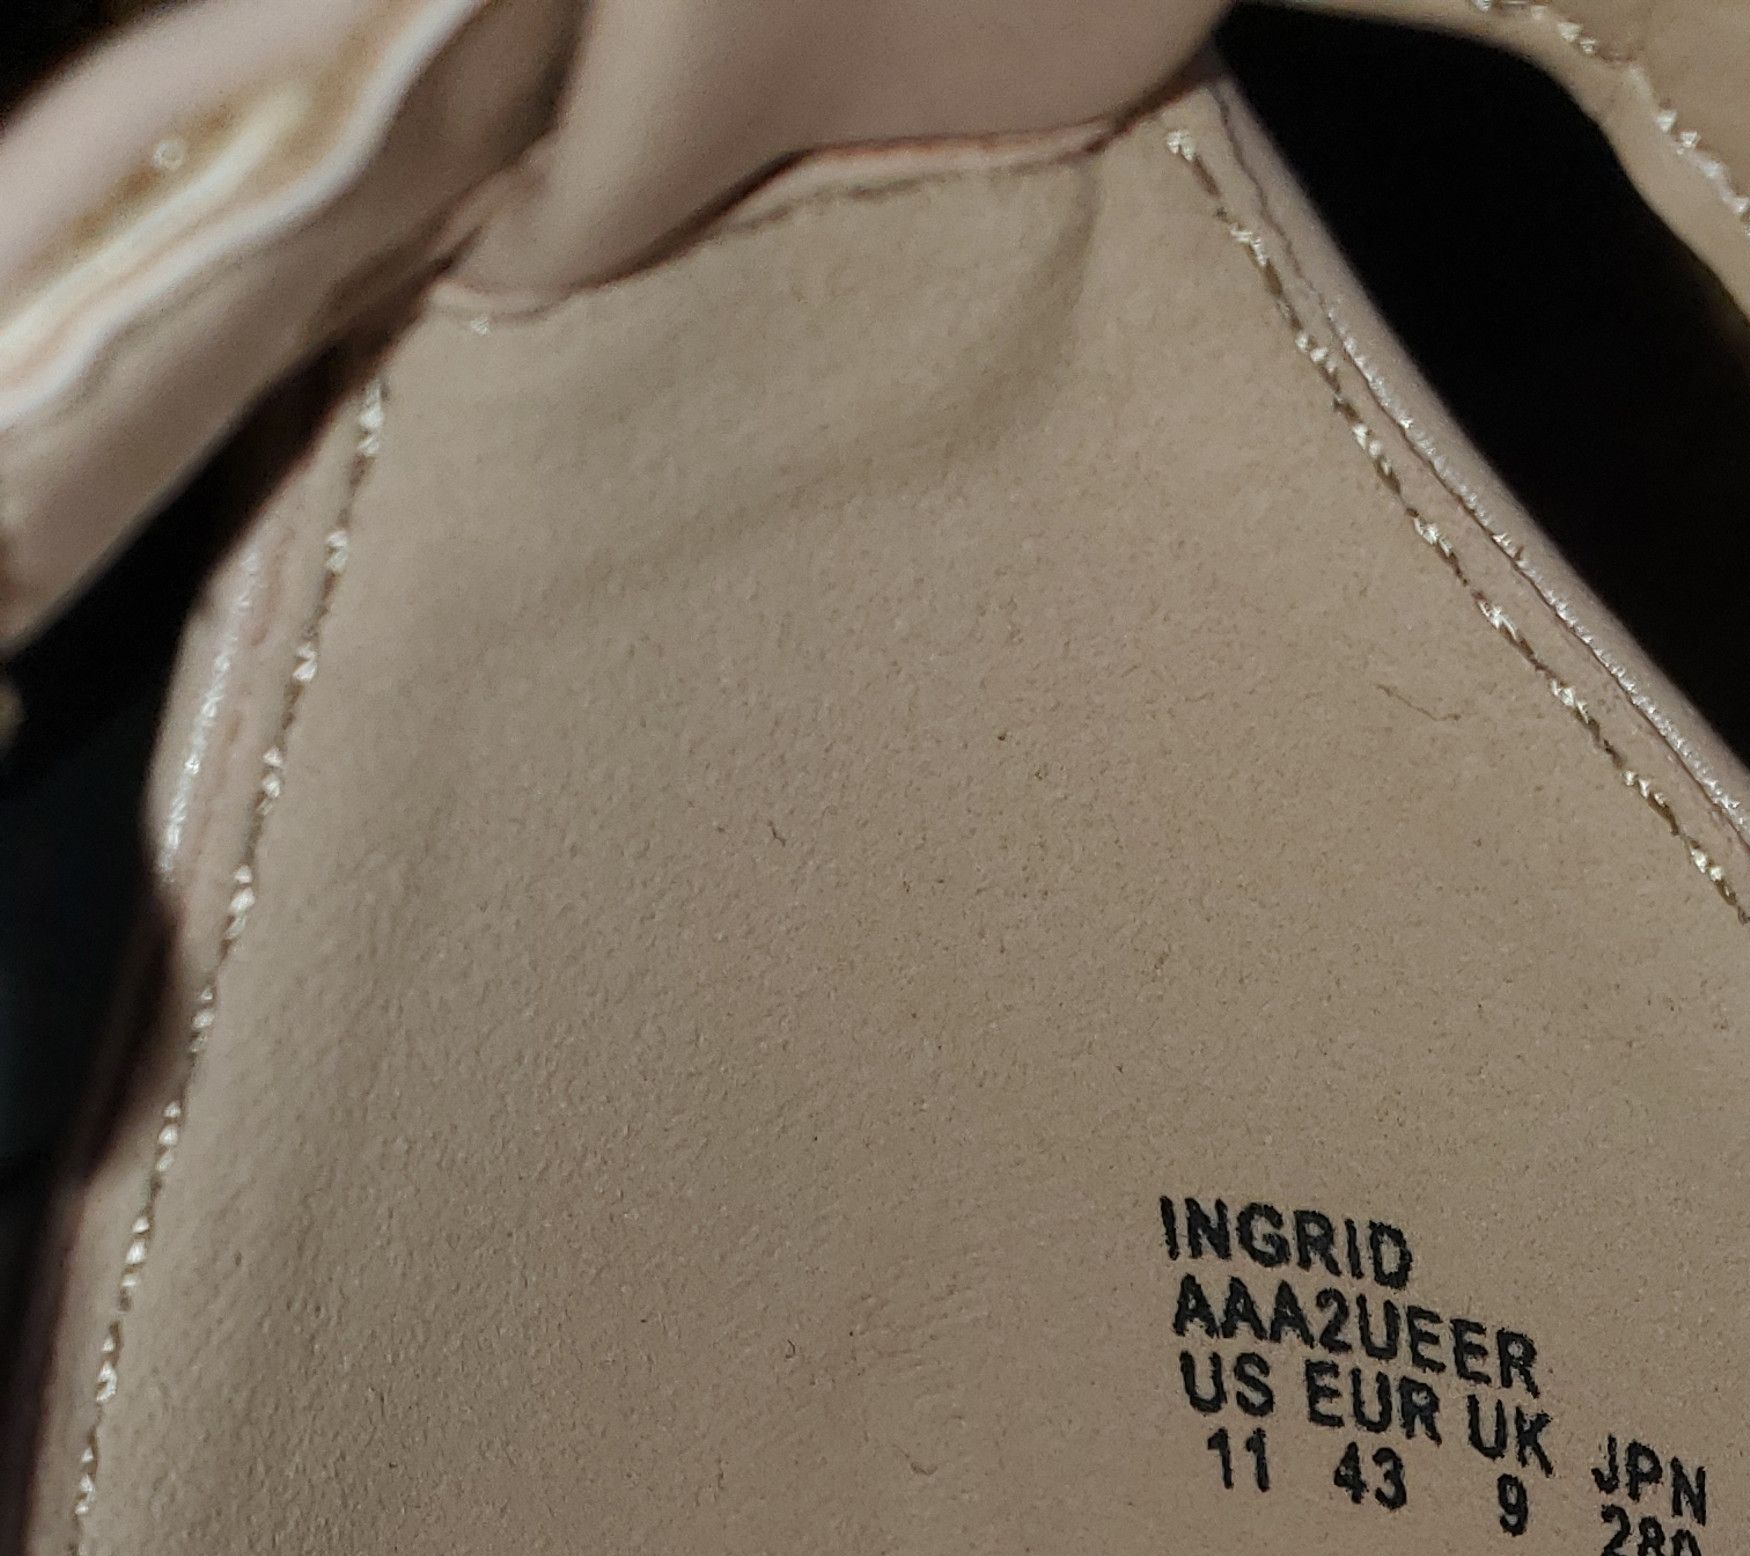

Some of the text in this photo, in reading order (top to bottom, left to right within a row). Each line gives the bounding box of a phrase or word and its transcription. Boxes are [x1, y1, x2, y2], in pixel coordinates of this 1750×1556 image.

[1160, 1196, 1415, 1289] INGRID
[1173, 1274, 1541, 1399] AAA2UEER
[1180, 1350, 1708, 1526] US EUR UK JPN
[1207, 1427, 1271, 1493] 11
[1334, 1441, 1408, 1511] 43
[1497, 1473, 1529, 1536] 9
